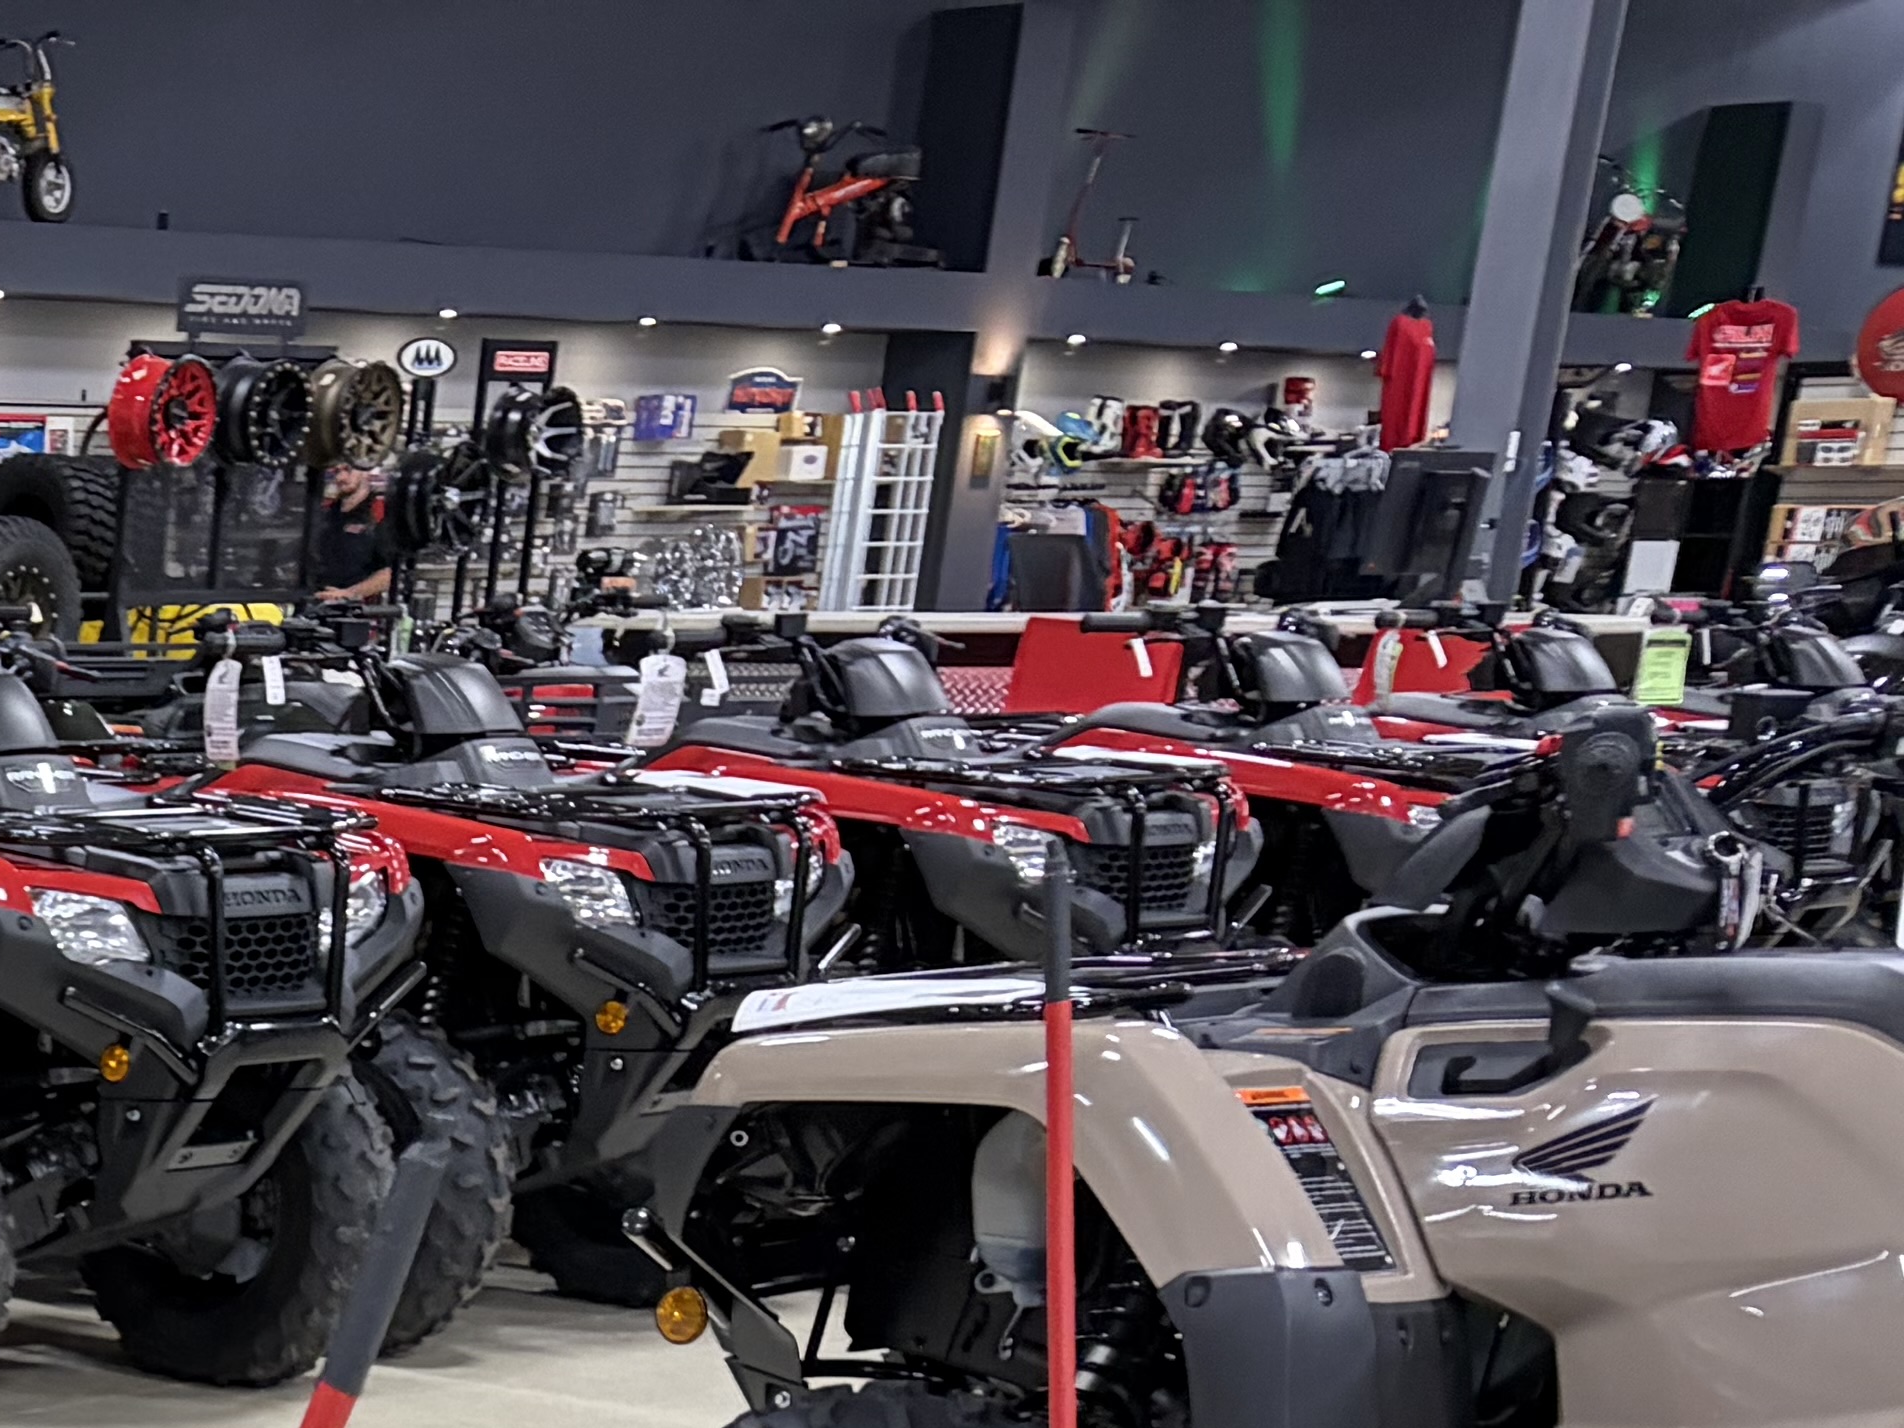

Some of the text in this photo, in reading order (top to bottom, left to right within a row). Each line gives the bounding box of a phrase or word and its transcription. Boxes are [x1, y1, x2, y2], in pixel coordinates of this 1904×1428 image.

[184, 283, 301, 317] SEDONA
[224, 888, 302, 907] HONDA
[1509, 1180, 1654, 1207] HONDA
